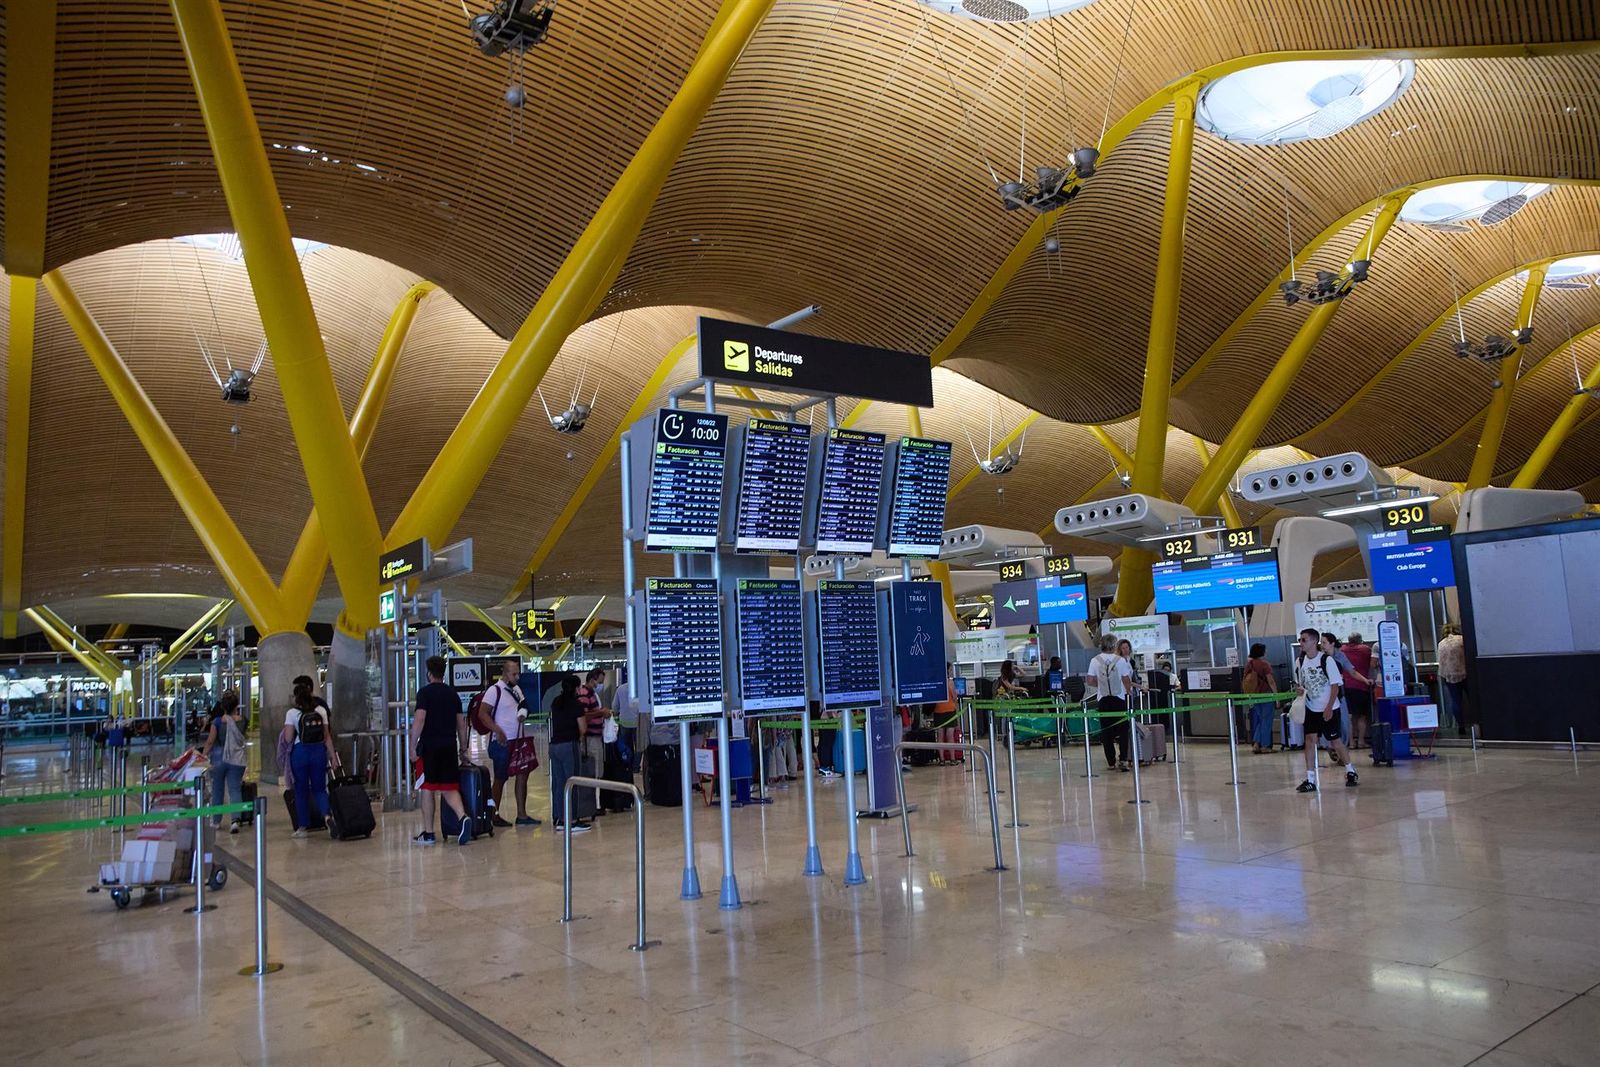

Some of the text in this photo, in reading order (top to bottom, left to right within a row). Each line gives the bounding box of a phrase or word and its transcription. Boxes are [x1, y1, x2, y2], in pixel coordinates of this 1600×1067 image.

[754, 346, 803, 365] Departures
[755, 360, 793, 377] Salidas
[759, 422, 789, 431] Facturación
[691, 427, 719, 441] 10:00
[839, 431, 865, 440] Facturación
[667, 446, 700, 455] Facturación
[1387, 506, 1424, 526] 930
[1228, 530, 1255, 547] 931
[1165, 539, 1193, 556] 932
[1002, 564, 1023, 579] 934
[1047, 557, 1070, 573] 933
[660, 581, 692, 589] Facturación
[1015, 599, 1029, 607] aena
[1040, 599, 1076, 609] BRITISH AIRWAYS
[72, 681, 109, 691] McDo
